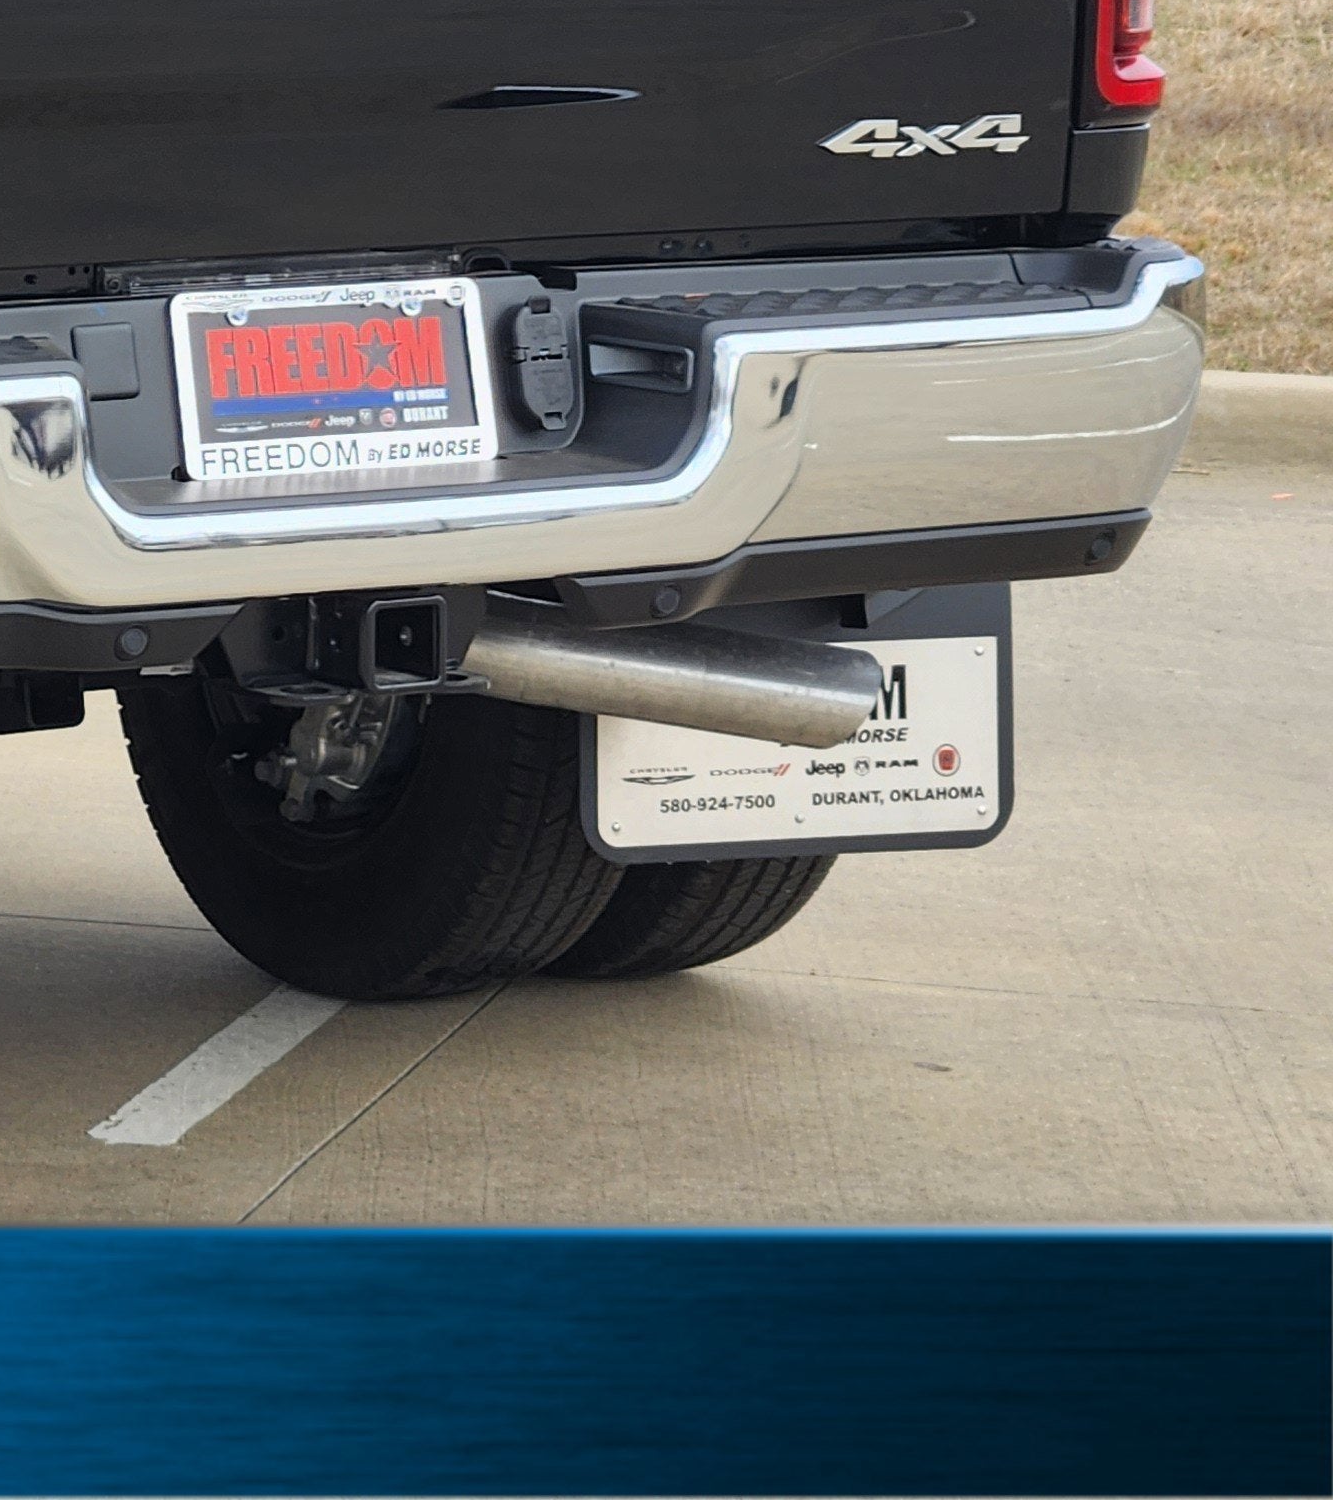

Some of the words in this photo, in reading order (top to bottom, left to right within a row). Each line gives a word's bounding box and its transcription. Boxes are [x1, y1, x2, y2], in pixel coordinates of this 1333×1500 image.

[339, 287, 376, 305] Jeep
[403, 289, 437, 297] RAM
[206, 316, 448, 398] FREEDOM
[324, 414, 356, 428] Jeep
[403, 406, 449, 423] DURANT
[201, 439, 361, 476] FREEDOM
[387, 443, 412, 460] ED
[415, 438, 482, 458] MORSE
[805, 759, 846, 778] Jeep
[874, 758, 919, 769] RAM
[659, 794, 776, 814] 580-924-7500
[812, 789, 885, 807] DURANT,
[889, 785, 986, 803] OKLAHOMA
